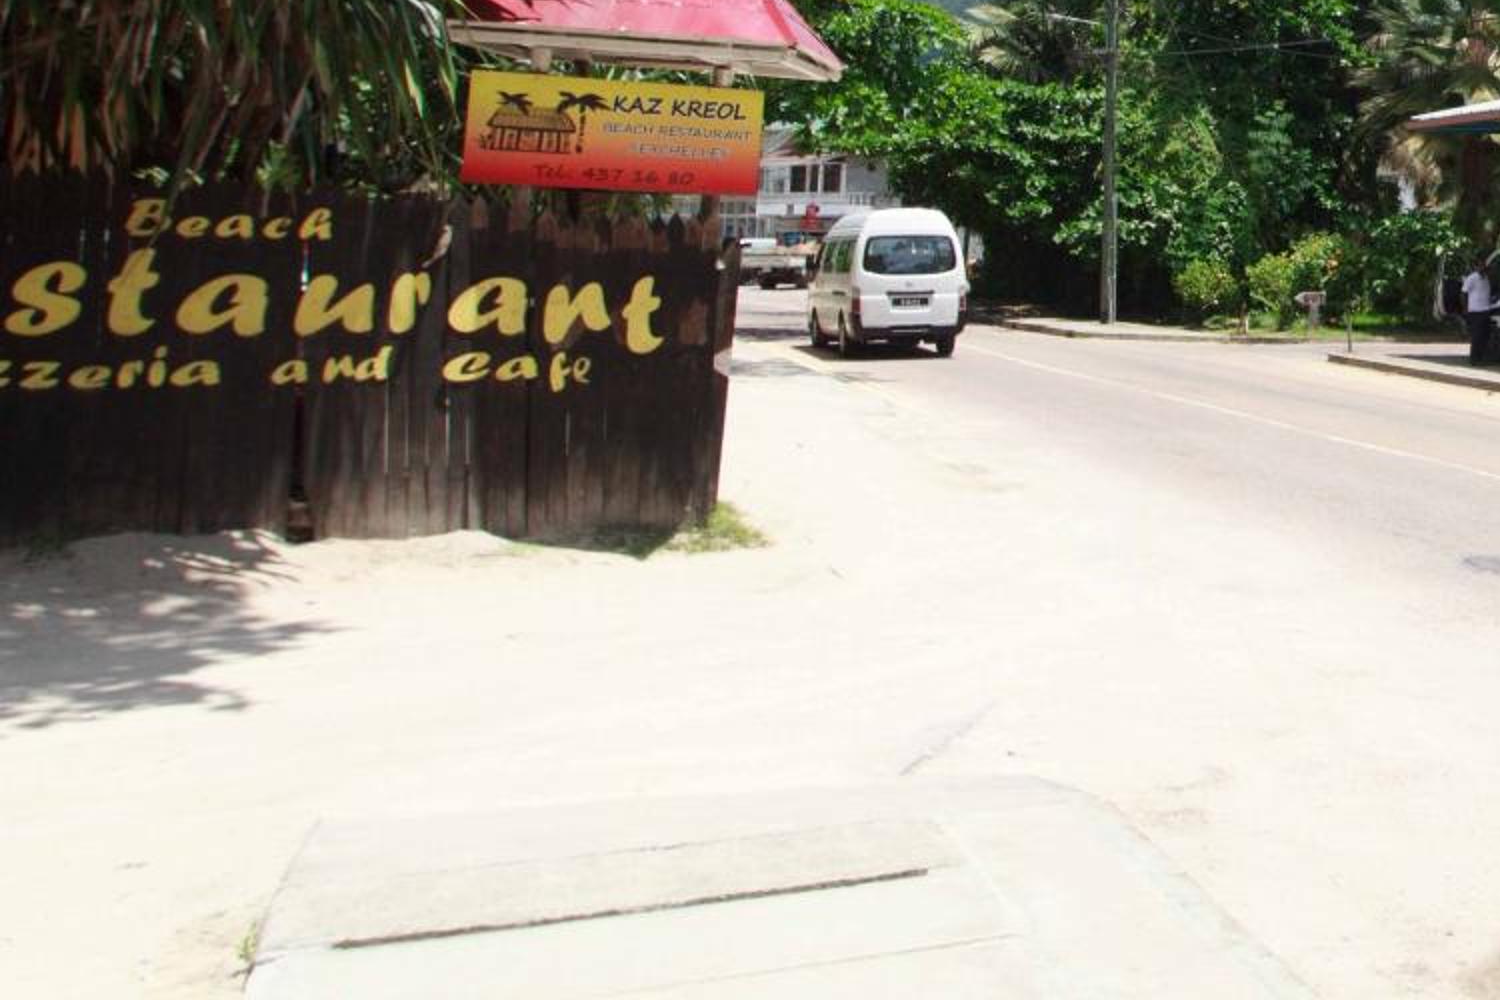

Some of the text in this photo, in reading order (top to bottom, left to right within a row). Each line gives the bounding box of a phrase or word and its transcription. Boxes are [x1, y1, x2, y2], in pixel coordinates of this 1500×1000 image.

[613, 95, 746, 121] KAZ KREOL
[602, 122, 753, 142] BEACH RESTAURANT
[125, 197, 333, 240] Beach
[0, 345, 221, 389] zeria
[271, 345, 394, 386] and
